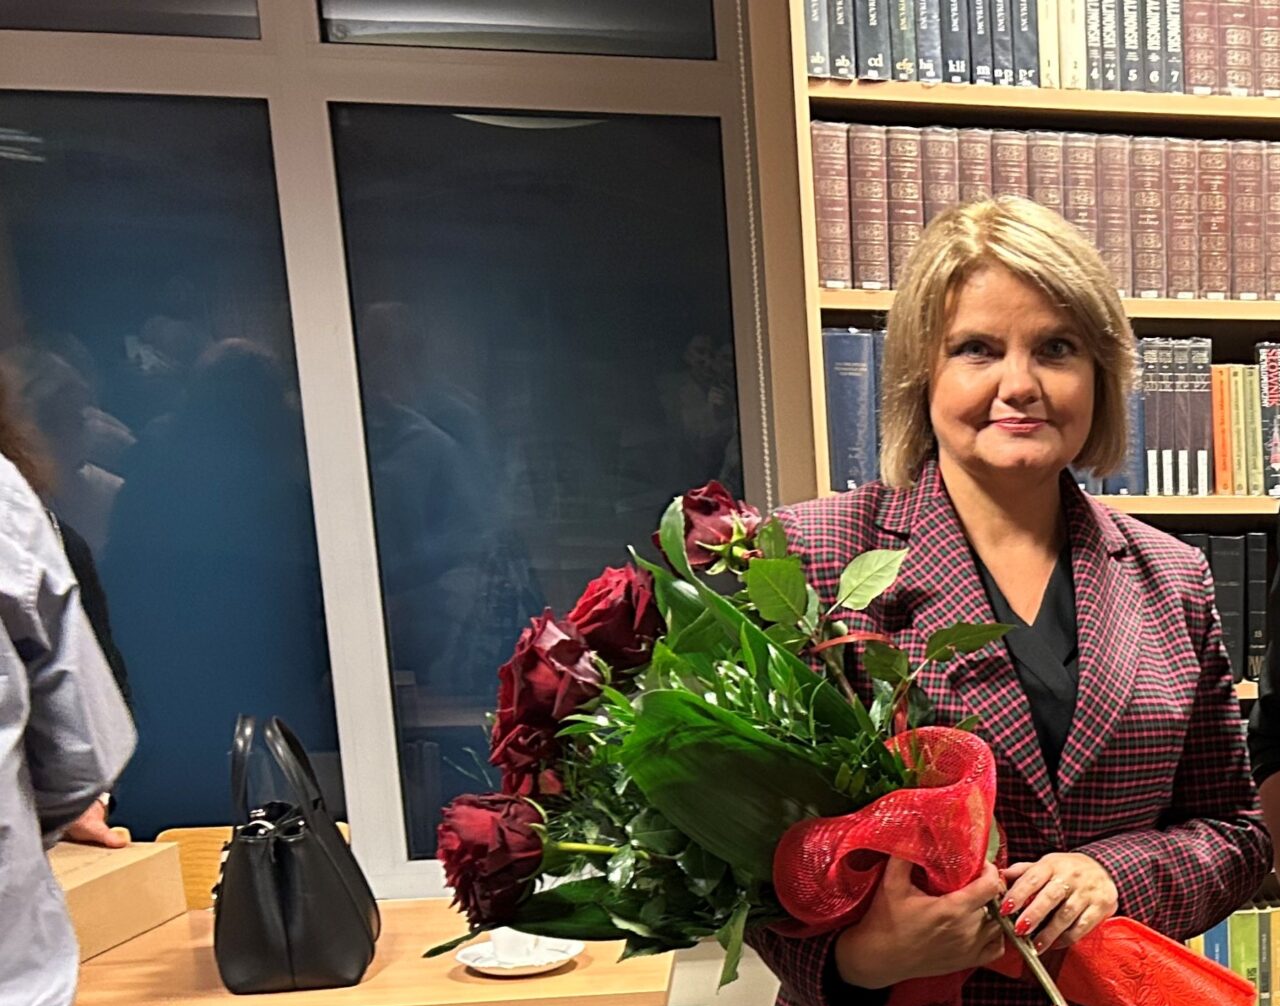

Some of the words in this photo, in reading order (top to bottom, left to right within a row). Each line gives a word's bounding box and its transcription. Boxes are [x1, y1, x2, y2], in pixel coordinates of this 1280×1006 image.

[810, 51, 825, 64] ab
[835, 55, 851, 67] ab
[867, 53, 883, 67] cd
[976, 65, 990, 76] m
[1090, 67, 1100, 80] 4
[1105, 69, 1116, 81] 4
[1128, 69, 1138, 82] 5
[1149, 70, 1160, 83] 6
[1170, 70, 1179, 83] 7
